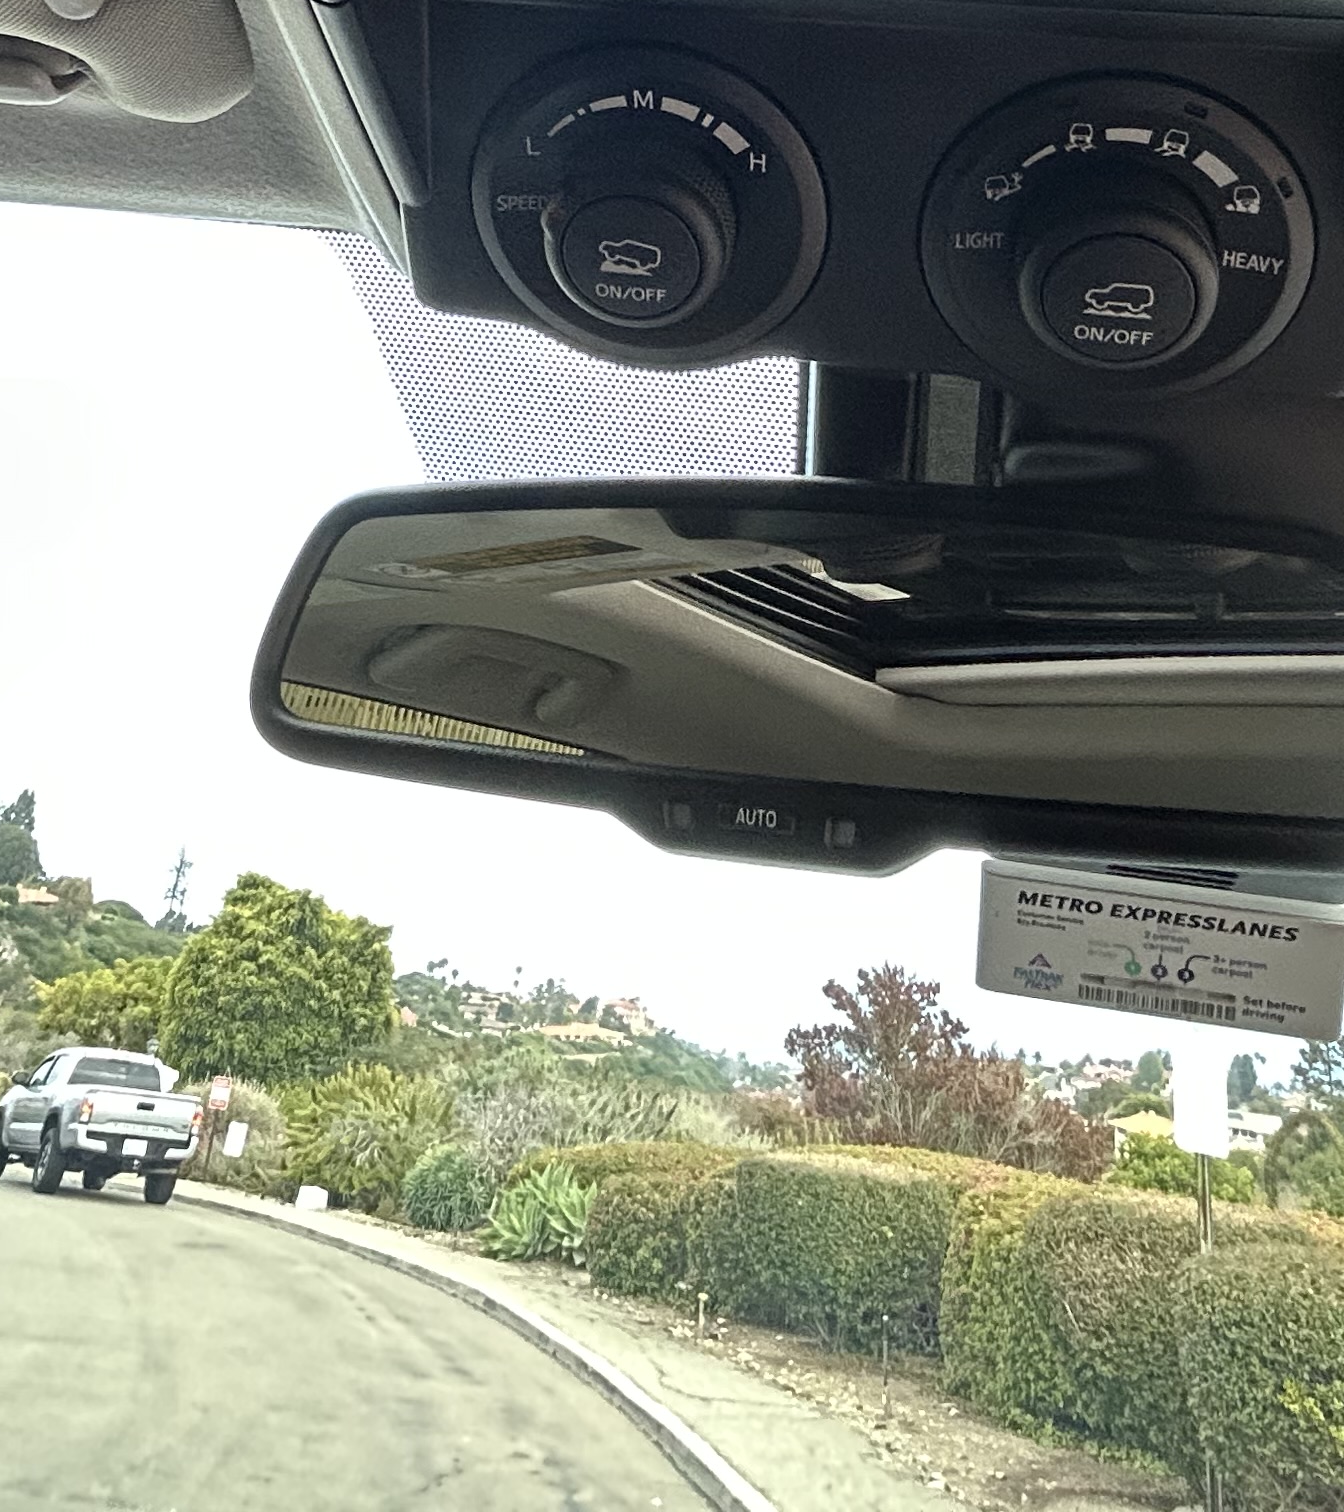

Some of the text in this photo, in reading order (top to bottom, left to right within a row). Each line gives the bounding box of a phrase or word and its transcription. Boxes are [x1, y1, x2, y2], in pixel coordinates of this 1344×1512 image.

[633, 90, 655, 110] M
[525, 136, 542, 157] L
[749, 153, 767, 173] H
[955, 231, 1005, 250] LIGHT
[1221, 249, 1285, 276] HEAVY
[594, 282, 668, 303] ON/OFF
[1073, 324, 1154, 346] ON/OFF
[735, 807, 777, 829] AUTO
[1017, 890, 1300, 943] METRO EXPRESSLANES
[1242, 994, 1306, 1015] Set before
[1240, 1007, 1285, 1024] driving
